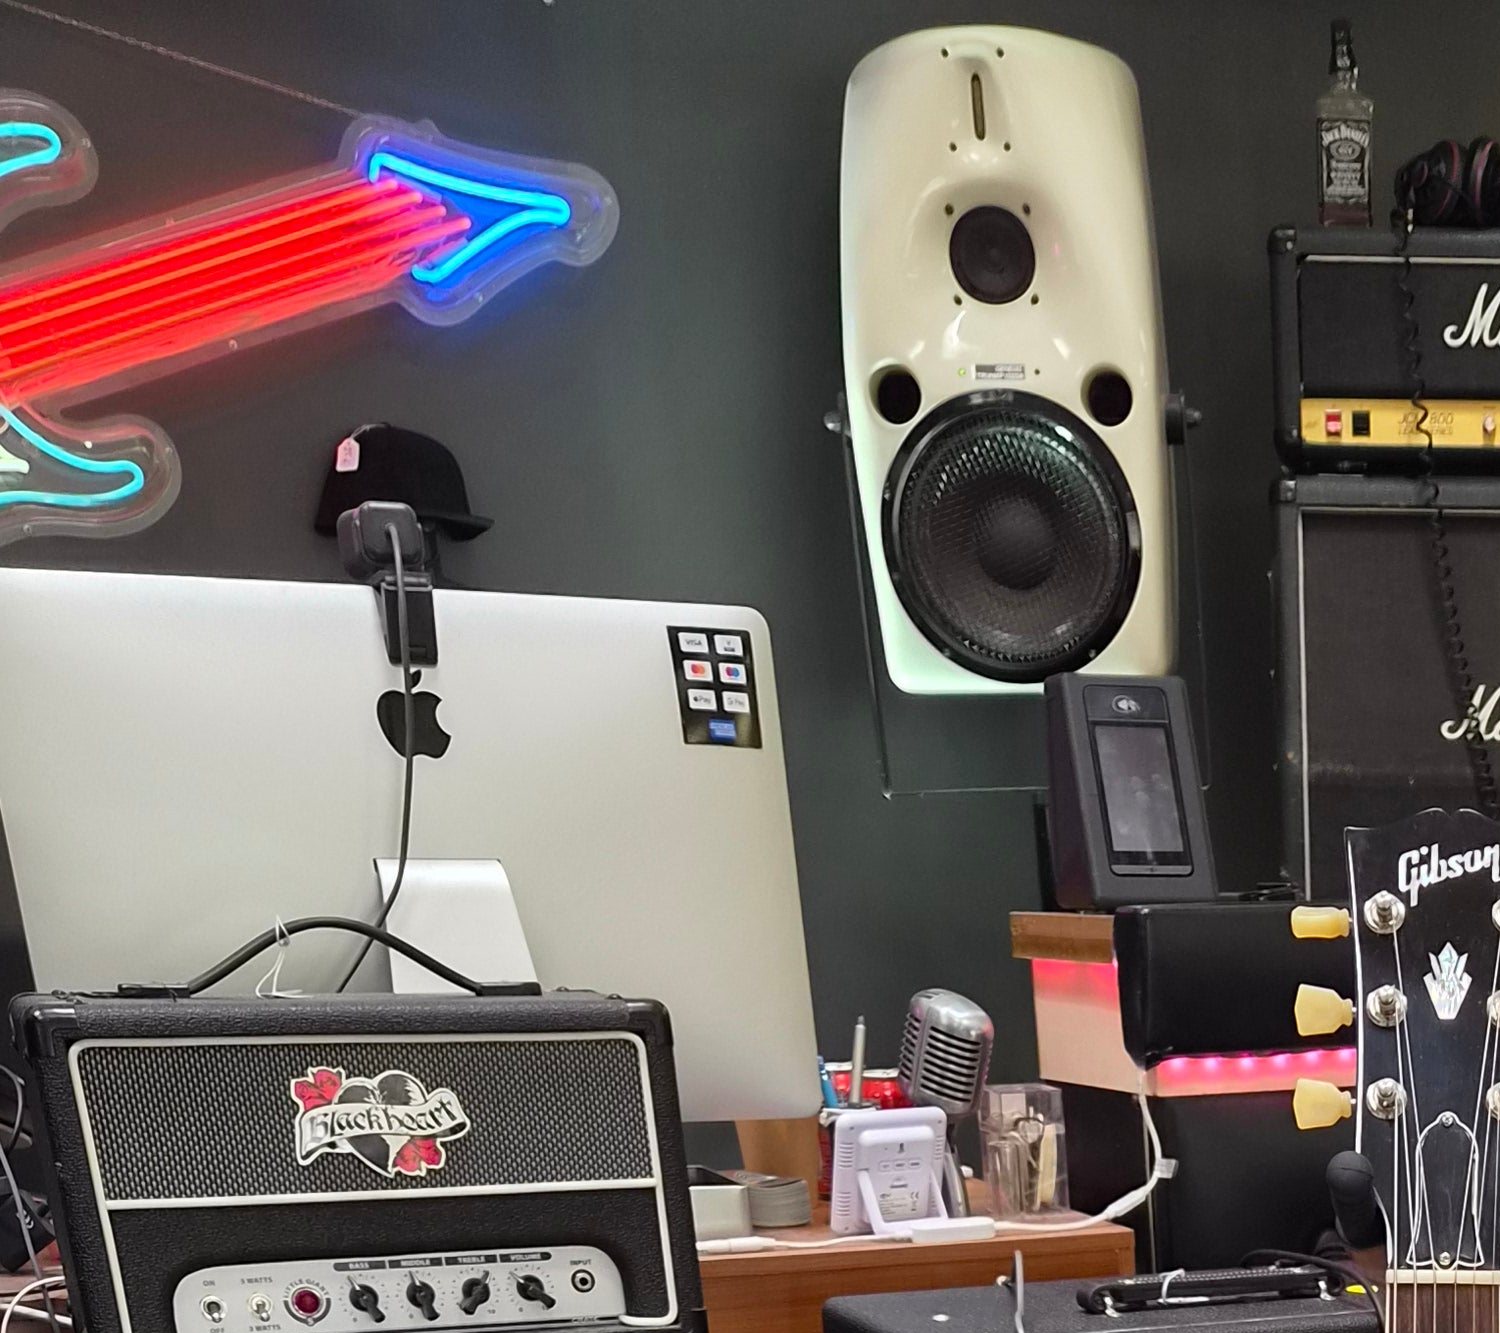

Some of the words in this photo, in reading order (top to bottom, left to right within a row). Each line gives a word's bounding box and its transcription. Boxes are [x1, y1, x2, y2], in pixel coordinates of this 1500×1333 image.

[306, 1099, 458, 1142] Blackheart
[457, 1254, 487, 1264] TREBLE
[510, 1252, 542, 1262] VOLUME
[348, 1261, 370, 1270] BASS
[400, 1258, 431, 1267] MIDDLE
[569, 1258, 592, 1266] INPUT
[202, 1279, 215, 1287] ON
[246, 1276, 273, 1284] WATTS
[254, 1324, 282, 1333] WATTS
